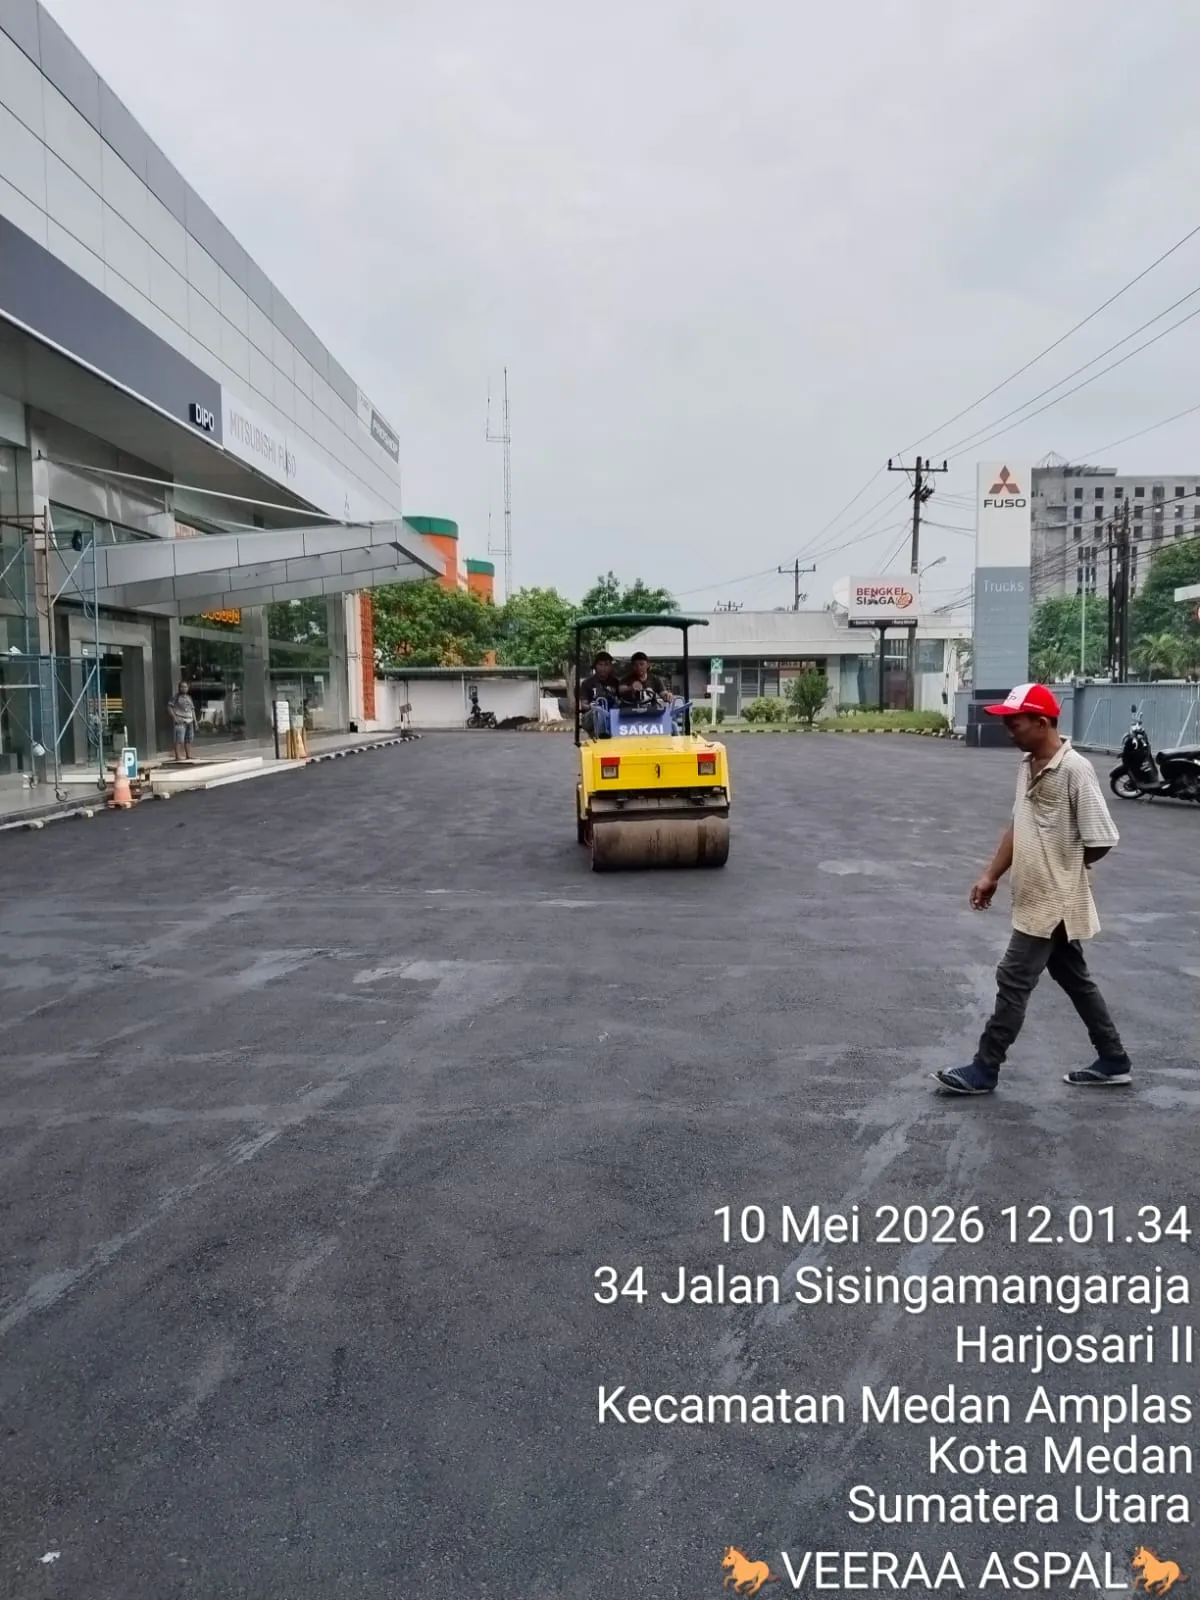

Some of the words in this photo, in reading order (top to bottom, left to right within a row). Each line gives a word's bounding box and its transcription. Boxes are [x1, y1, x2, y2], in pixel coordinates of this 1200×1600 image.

[195, 402, 215, 432] DIPO
[229, 409, 276, 465] MITSUBISHI
[983, 498, 1026, 508] FUSO
[983, 579, 1025, 593] Trucks
[619, 723, 664, 736] SAKAI
